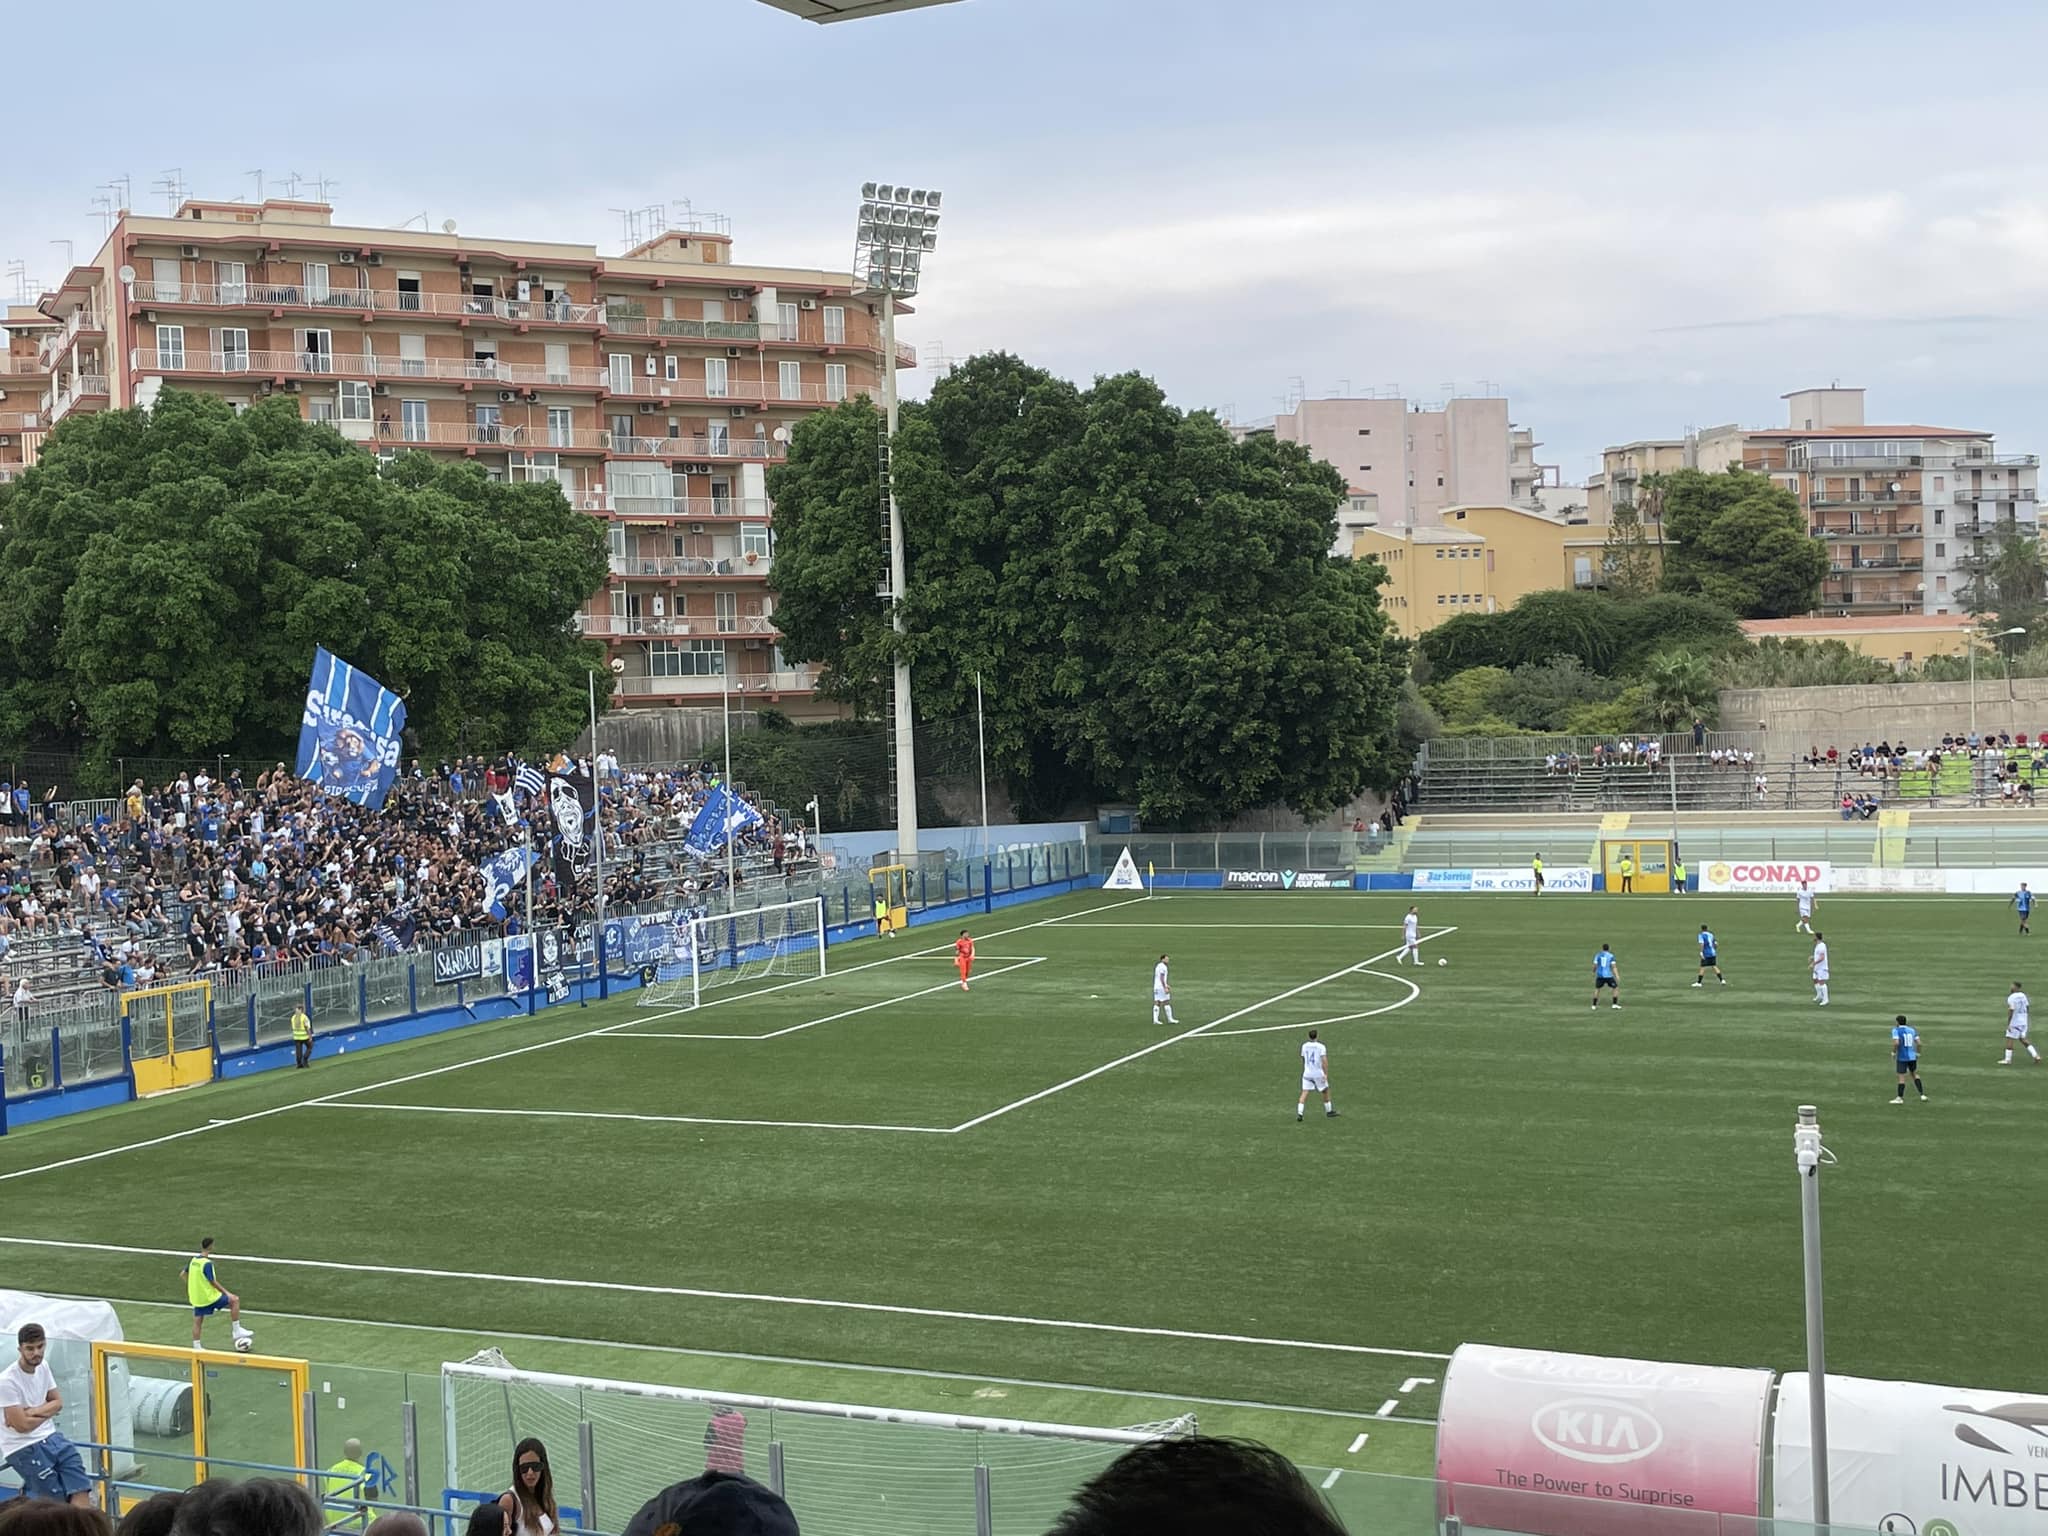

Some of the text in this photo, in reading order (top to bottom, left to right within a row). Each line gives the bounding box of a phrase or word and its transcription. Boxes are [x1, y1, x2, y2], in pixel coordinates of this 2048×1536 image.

[1228, 871, 1278, 883] macron
[1732, 865, 1821, 882] CONAD
[1314, 880, 1330, 888] OWN
[1501, 879, 1587, 889] COSTUZIONI
[437, 944, 479, 976] SANDRO
[1556, 1410, 1640, 1449] KIA
[1495, 1468, 1695, 1507] The Power to Surprise
